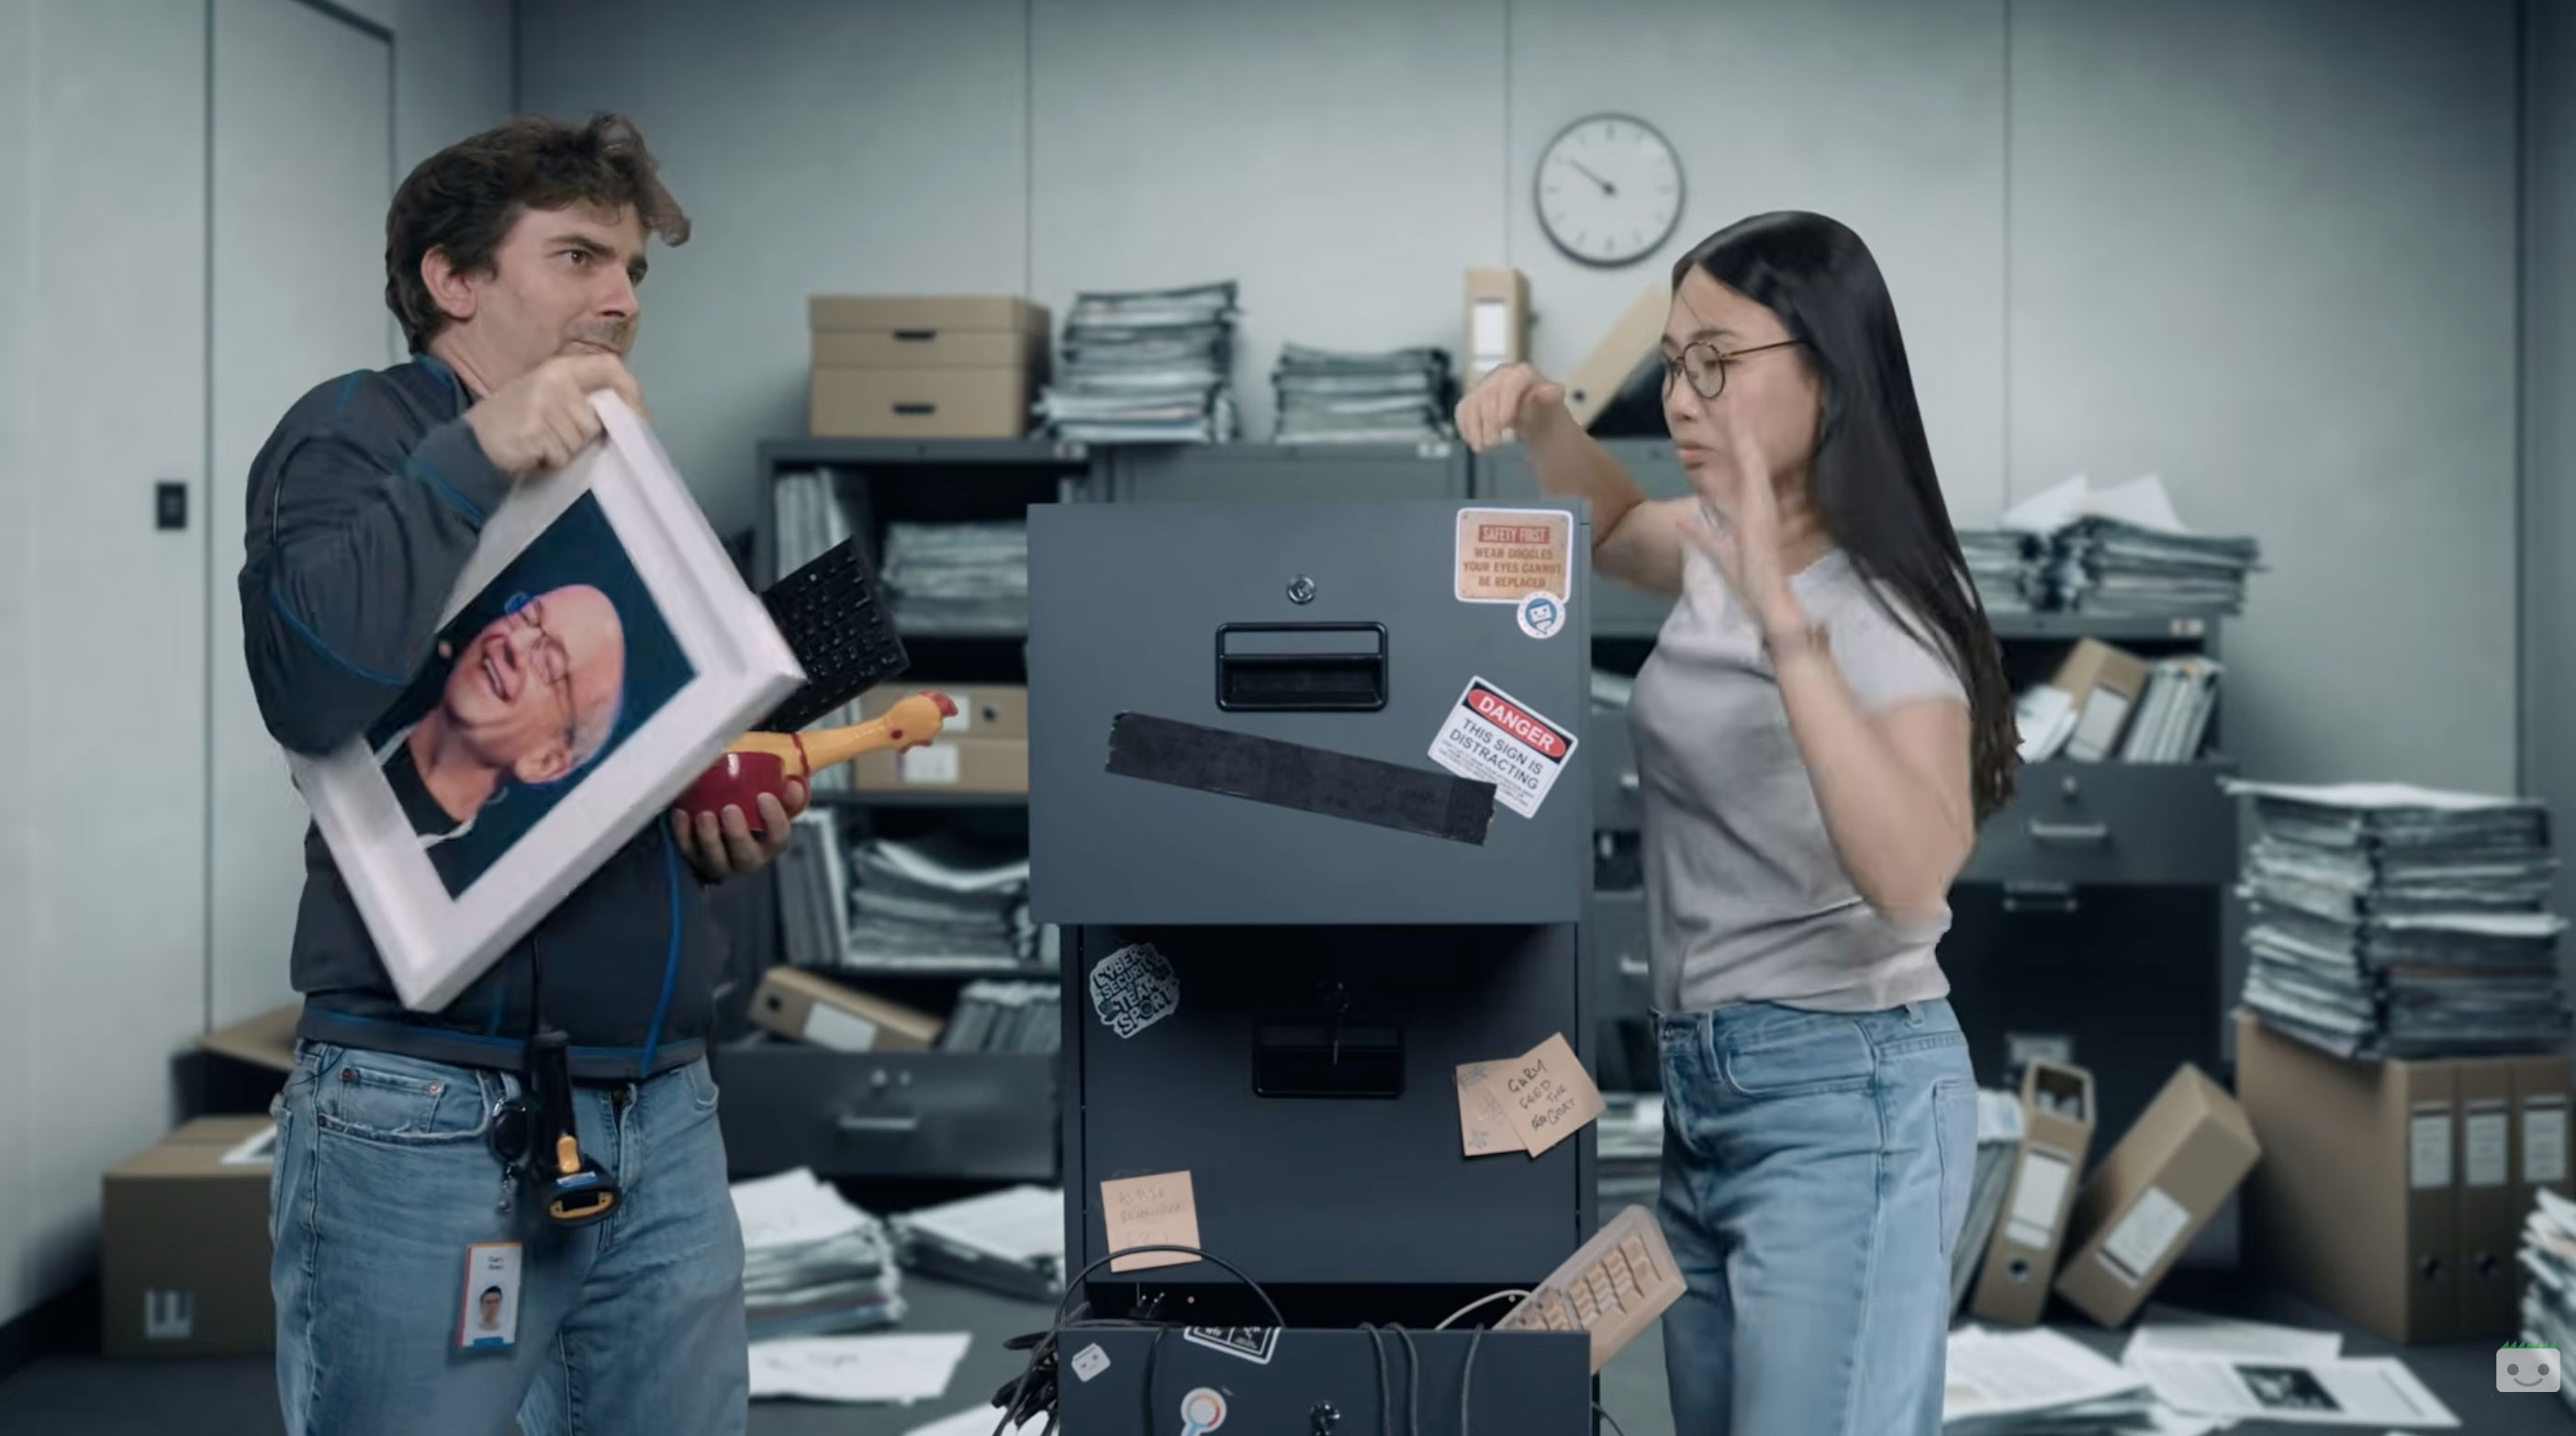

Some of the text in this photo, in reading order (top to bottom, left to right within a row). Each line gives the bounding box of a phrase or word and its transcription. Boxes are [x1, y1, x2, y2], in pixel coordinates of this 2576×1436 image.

[1483, 526, 1544, 543] SAFETY FIRST
[1462, 561, 1562, 574] YOUR EYES CANNOT
[1474, 547, 1553, 560] WEAR GOGGLES
[1478, 576, 1546, 588] BE REPLACED
[1477, 695, 1555, 752] DANGER
[1450, 728, 1540, 791] DISTRACTING
[1462, 717, 1494, 745] THIS
[1494, 738, 1529, 765] SIGN
[1528, 759, 1544, 776] IS
[1093, 949, 1141, 986] CYBER
[1111, 972, 1159, 1012] TEAM
[1118, 983, 1174, 1033] SPORT
[1546, 1084, 1567, 1104] THE
[1547, 1098, 1575, 1126] GOAT
